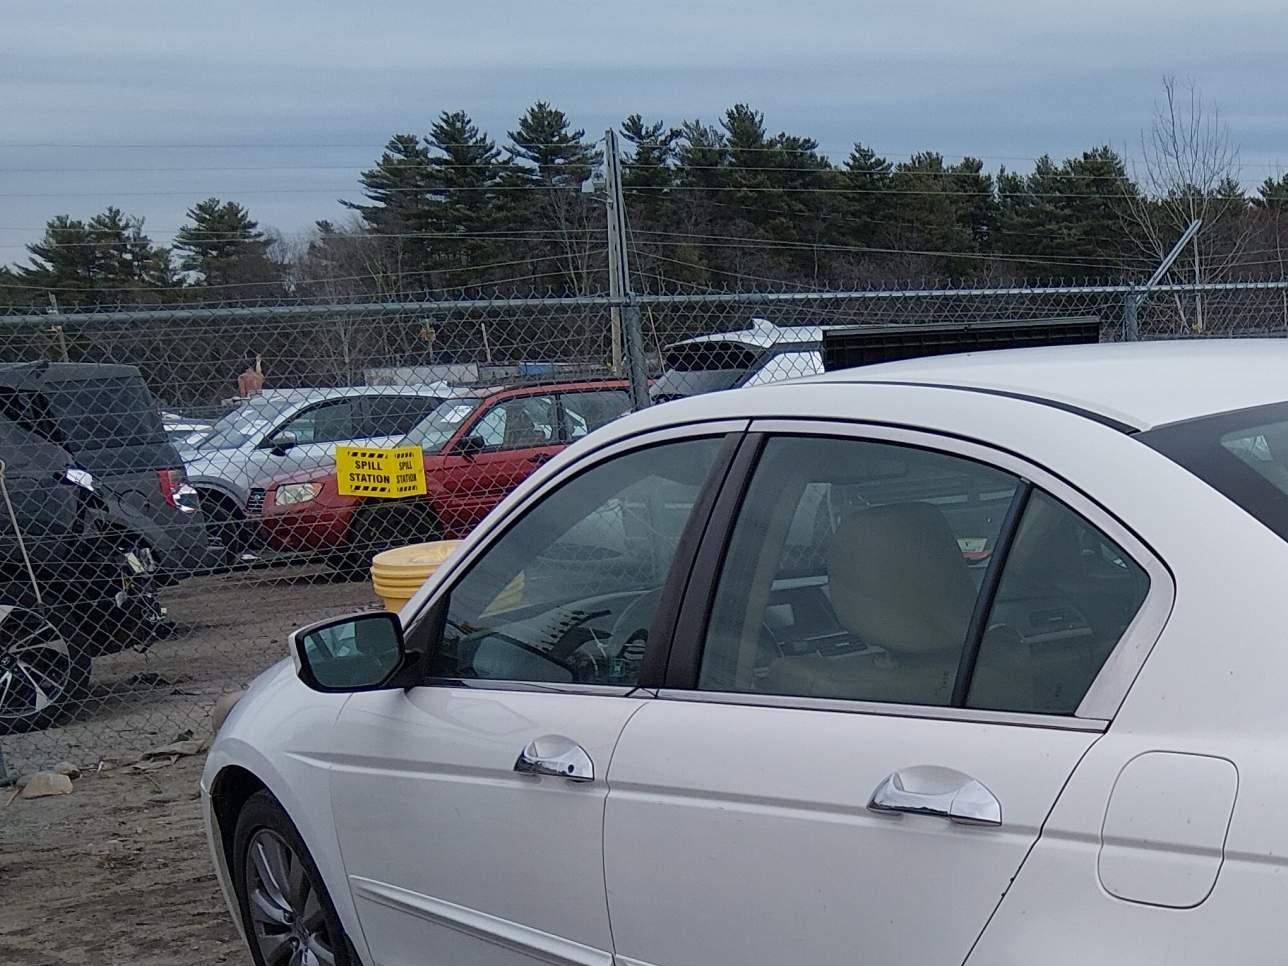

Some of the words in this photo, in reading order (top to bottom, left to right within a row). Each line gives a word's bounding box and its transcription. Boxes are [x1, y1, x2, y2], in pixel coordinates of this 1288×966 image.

[355, 460, 383, 471] SPILL
[399, 461, 413, 471] SPILL
[349, 473, 390, 484] STATION
[396, 473, 417, 484] STATION
